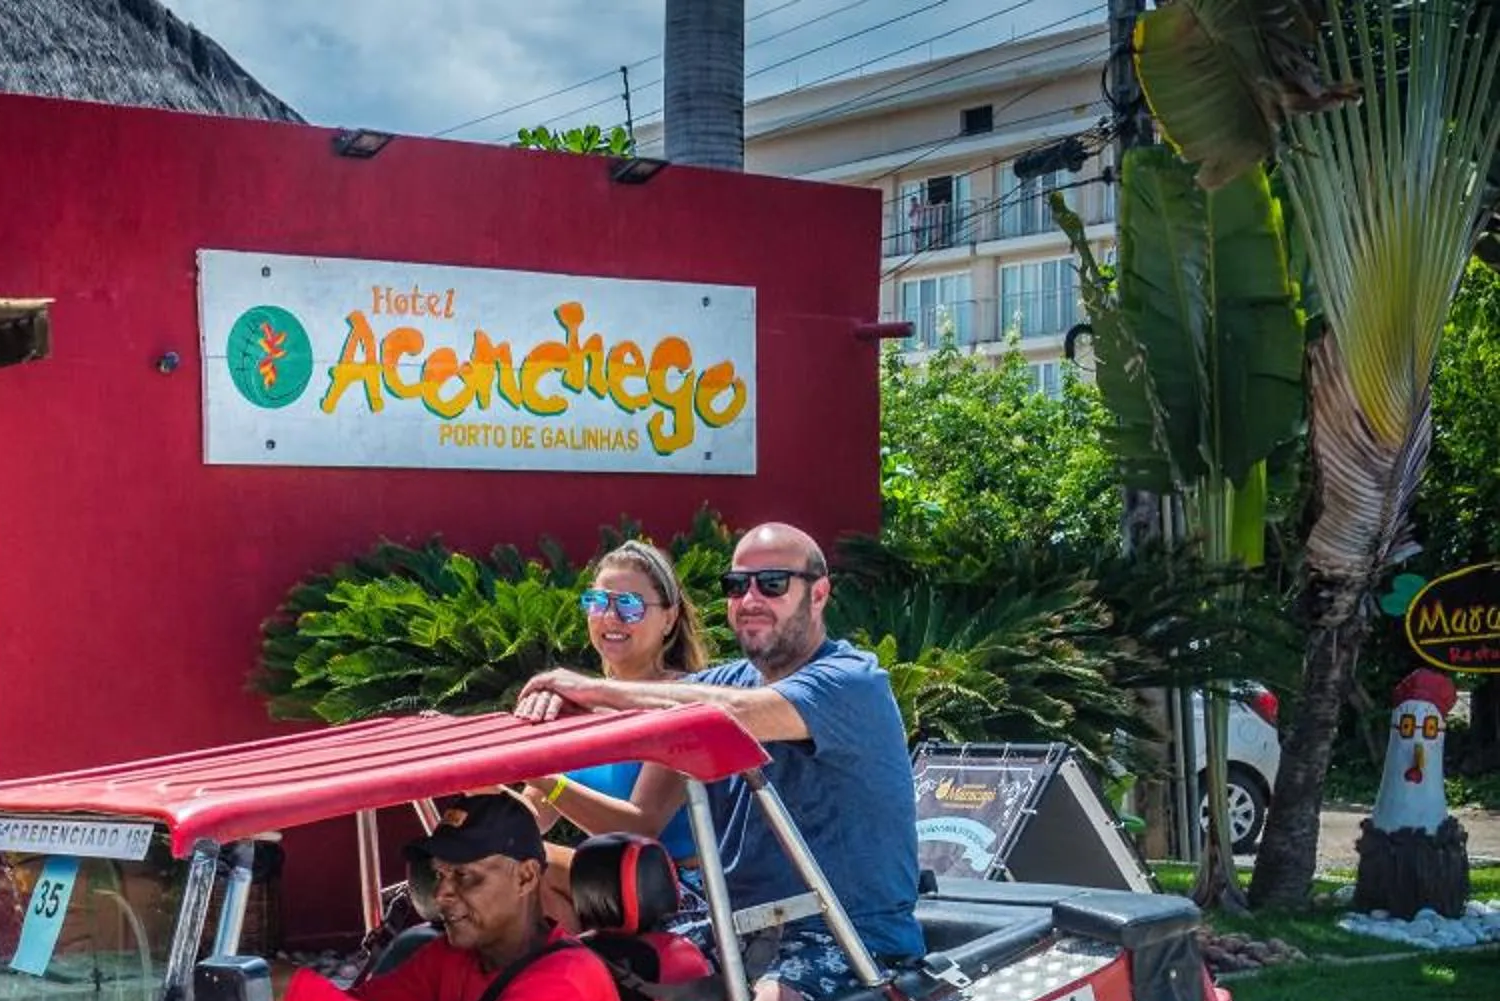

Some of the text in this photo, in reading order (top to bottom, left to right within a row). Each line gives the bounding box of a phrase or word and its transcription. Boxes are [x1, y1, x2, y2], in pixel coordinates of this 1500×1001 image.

[371, 285, 456, 319] Hotel
[319, 301, 746, 456] Aconchego
[438, 423, 640, 452] PORTO DE GALINHAS
[34, 879, 62, 918] 35
